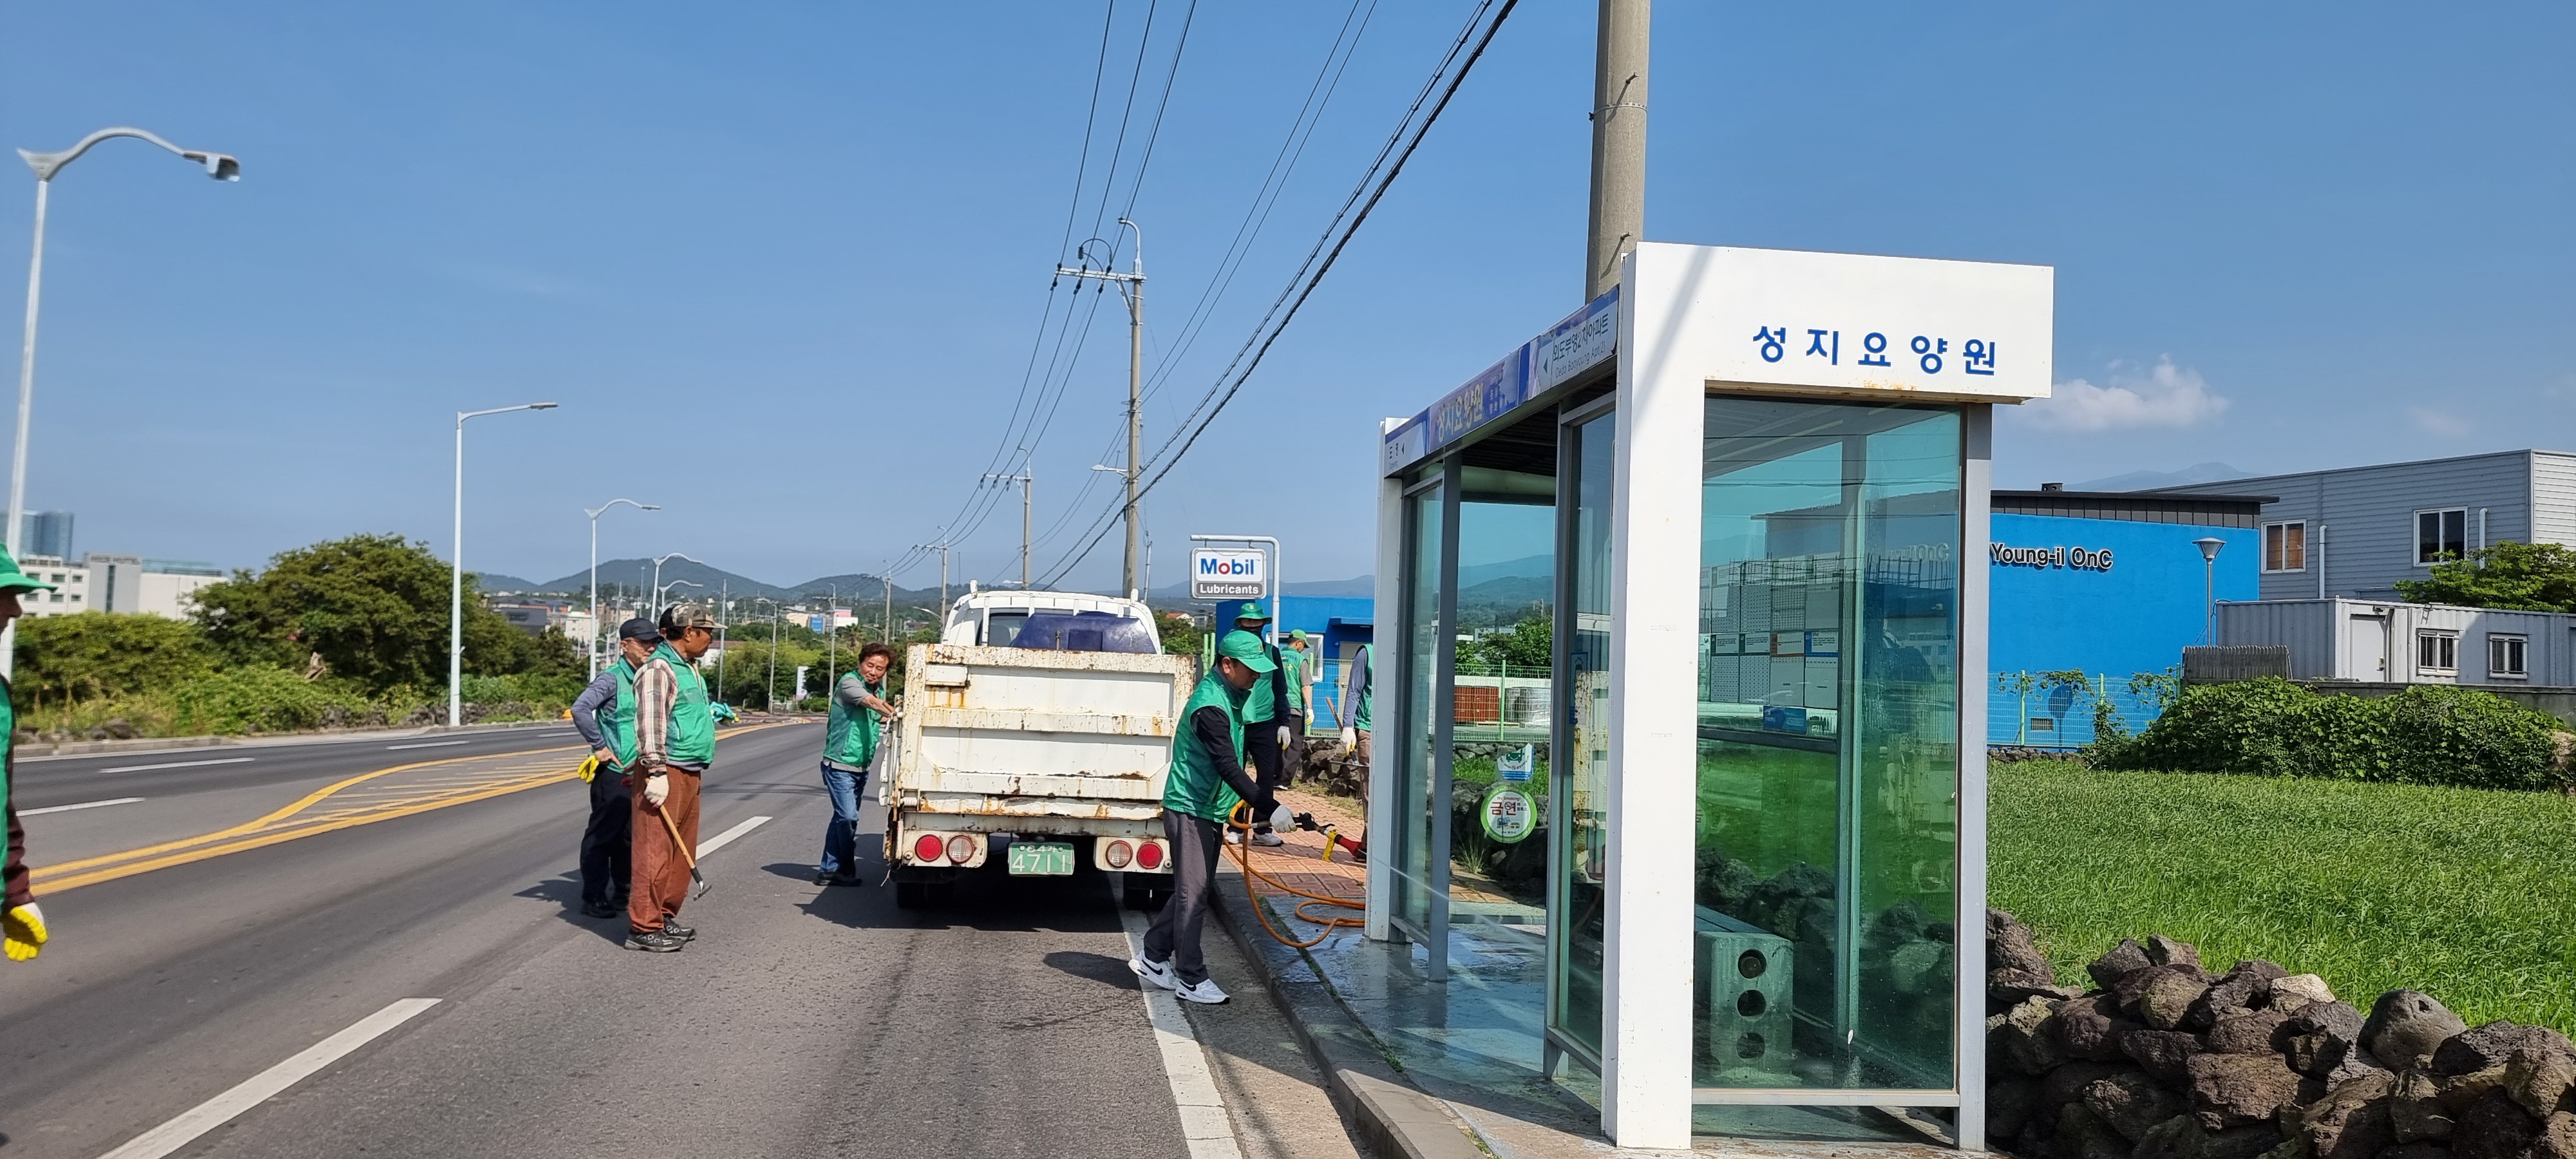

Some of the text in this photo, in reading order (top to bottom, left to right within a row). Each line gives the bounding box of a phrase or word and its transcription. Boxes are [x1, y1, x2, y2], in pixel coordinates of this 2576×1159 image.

[1553, 313, 1609, 362] 외도부영2차아파트
[1752, 325, 1996, 377] 성지요양원
[1437, 382, 1484, 443] 성지요양원
[1200, 558, 1255, 575] Mobil
[1989, 542, 2114, 570] Young-il OnC
[1200, 583, 1259, 594] Lubricants
[1490, 801, 1517, 816] 금연
[1011, 854, 1066, 872] 4711
